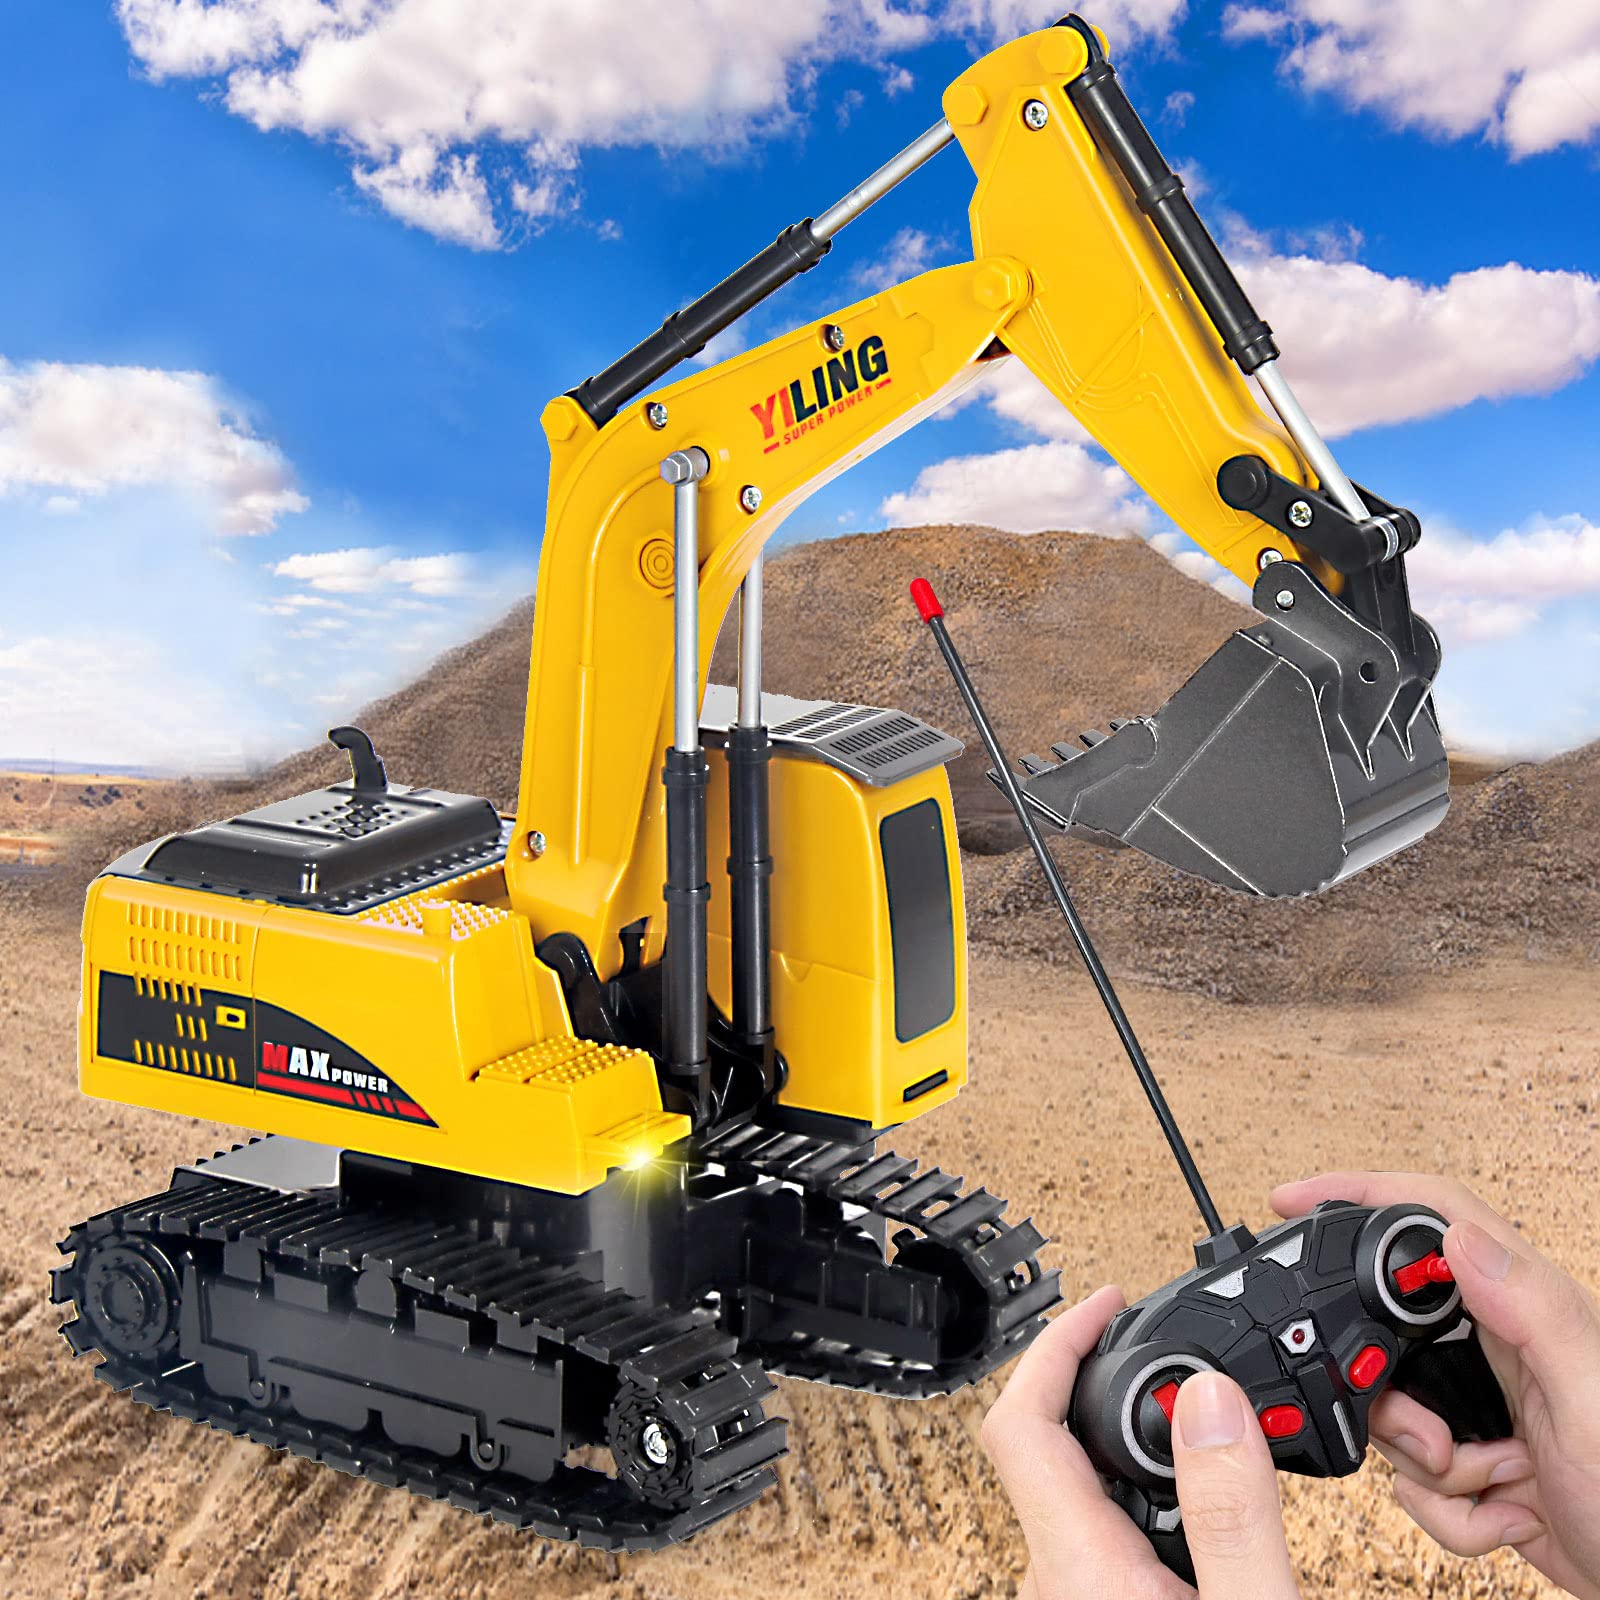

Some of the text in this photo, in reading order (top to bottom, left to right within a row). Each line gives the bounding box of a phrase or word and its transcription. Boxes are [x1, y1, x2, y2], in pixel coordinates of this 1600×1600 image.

[750, 335, 889, 440] YILING
[783, 386, 873, 445] SUPER POWER
[262, 1041, 389, 1093] MAX POWER
